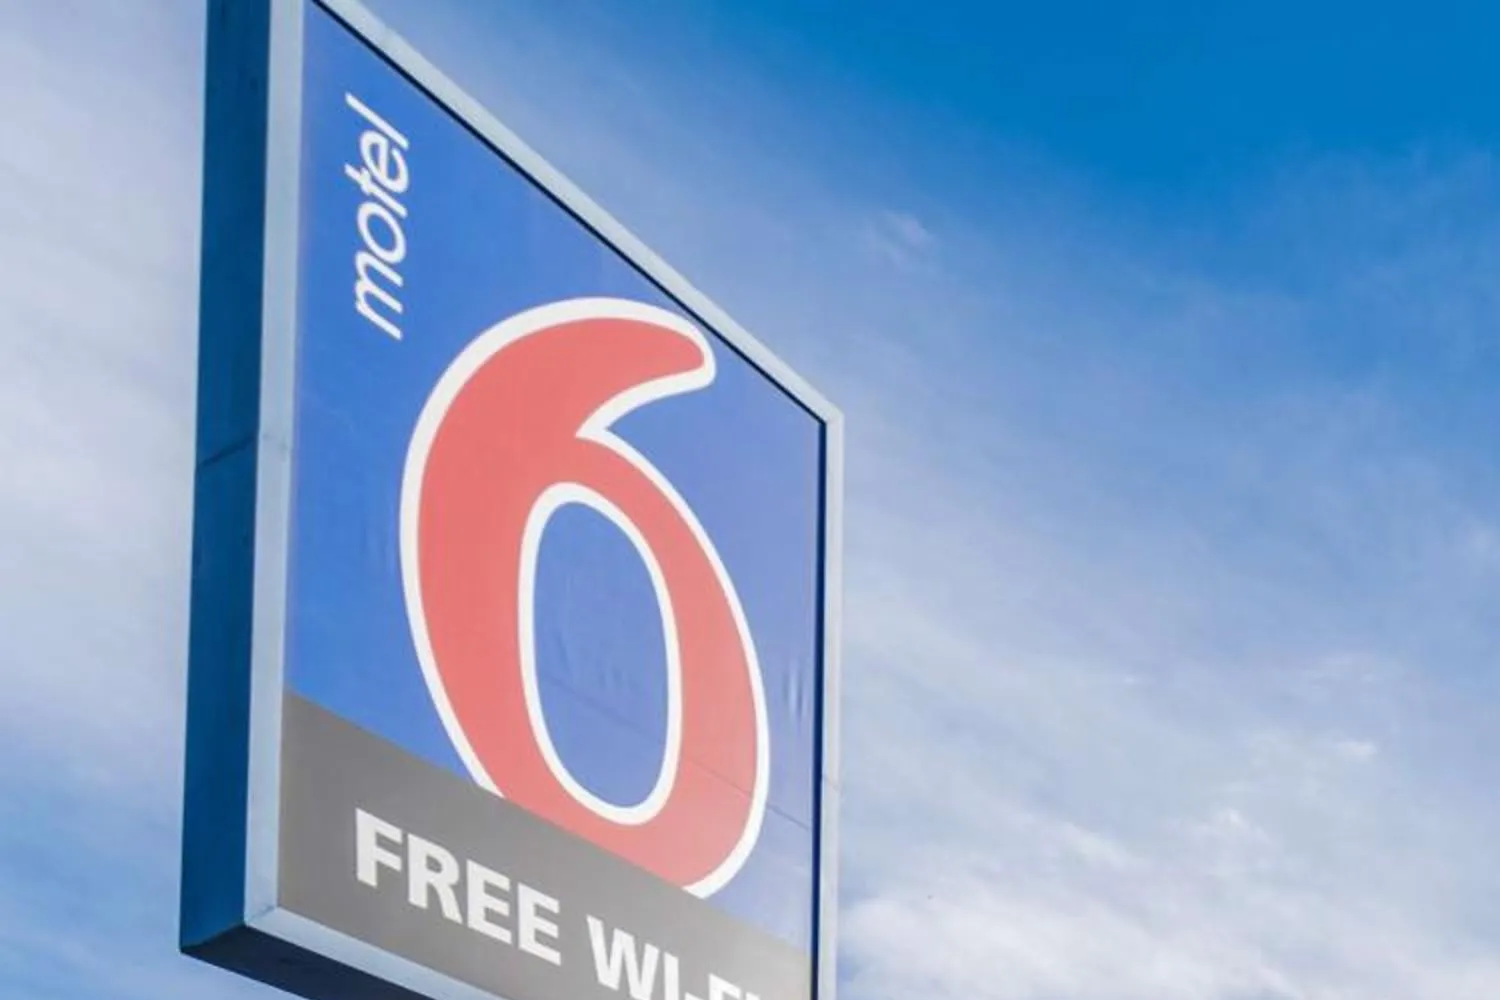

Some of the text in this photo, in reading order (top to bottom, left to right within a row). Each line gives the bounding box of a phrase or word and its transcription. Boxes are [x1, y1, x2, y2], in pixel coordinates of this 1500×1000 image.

[345, 93, 410, 340] motel
[400, 296, 773, 899] 6
[354, 807, 562, 967] FREE
